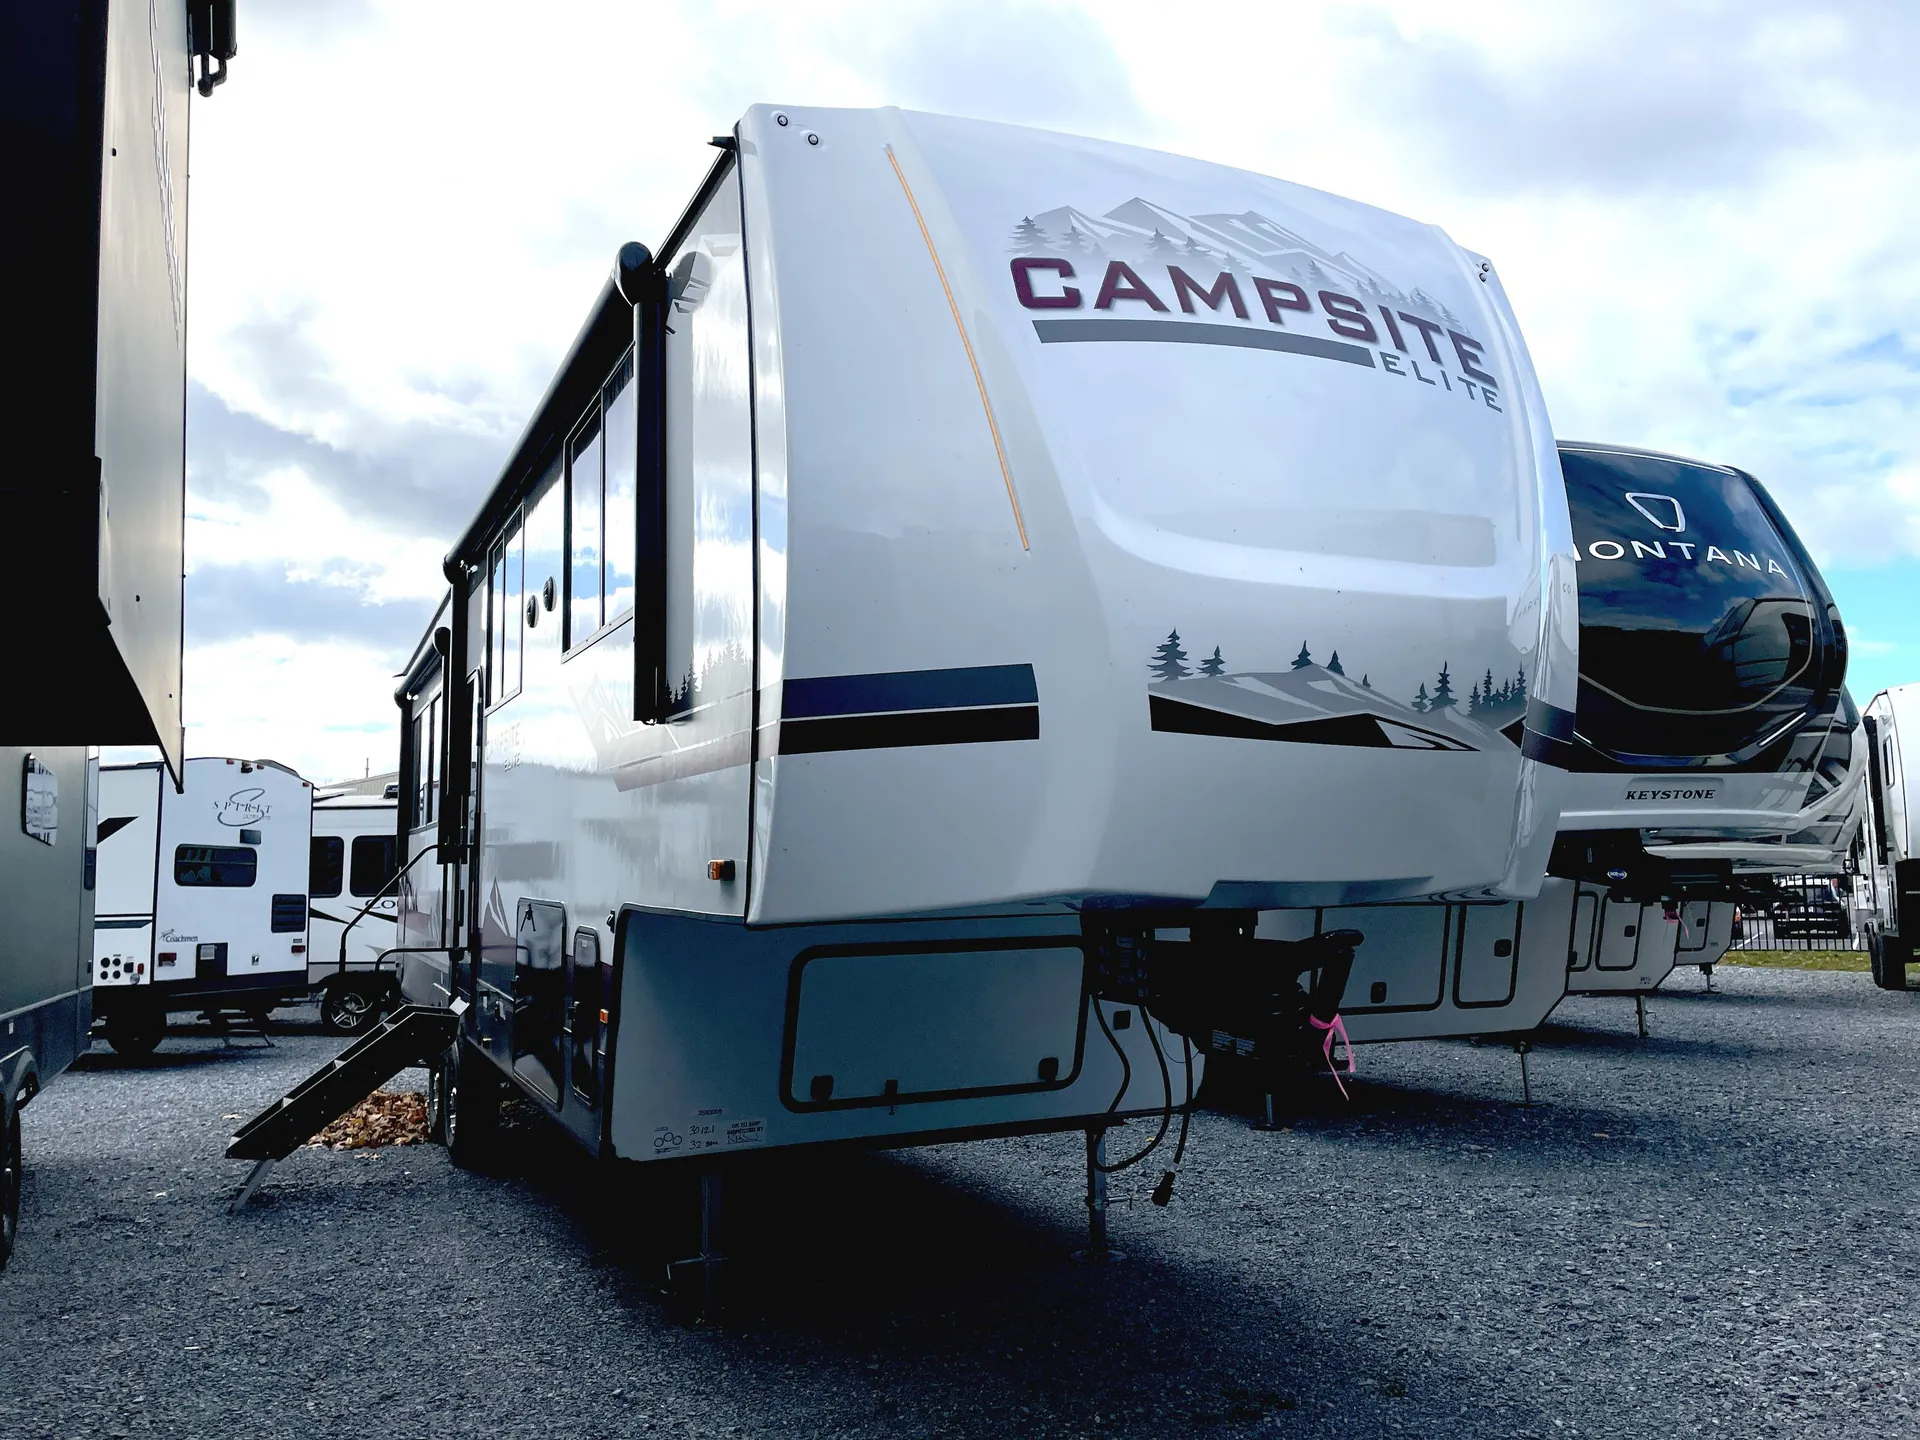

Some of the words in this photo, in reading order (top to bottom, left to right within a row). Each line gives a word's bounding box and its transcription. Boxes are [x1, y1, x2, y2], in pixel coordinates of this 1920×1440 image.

[1009, 256, 1498, 388] CAMPSITE
[1378, 350, 1503, 413] ELITE
[1573, 540, 1788, 580] ONTANA
[212, 800, 273, 814] SPIRIT
[1624, 788, 1716, 800] KEYSTONE
[164, 934, 199, 943] Coachmen
